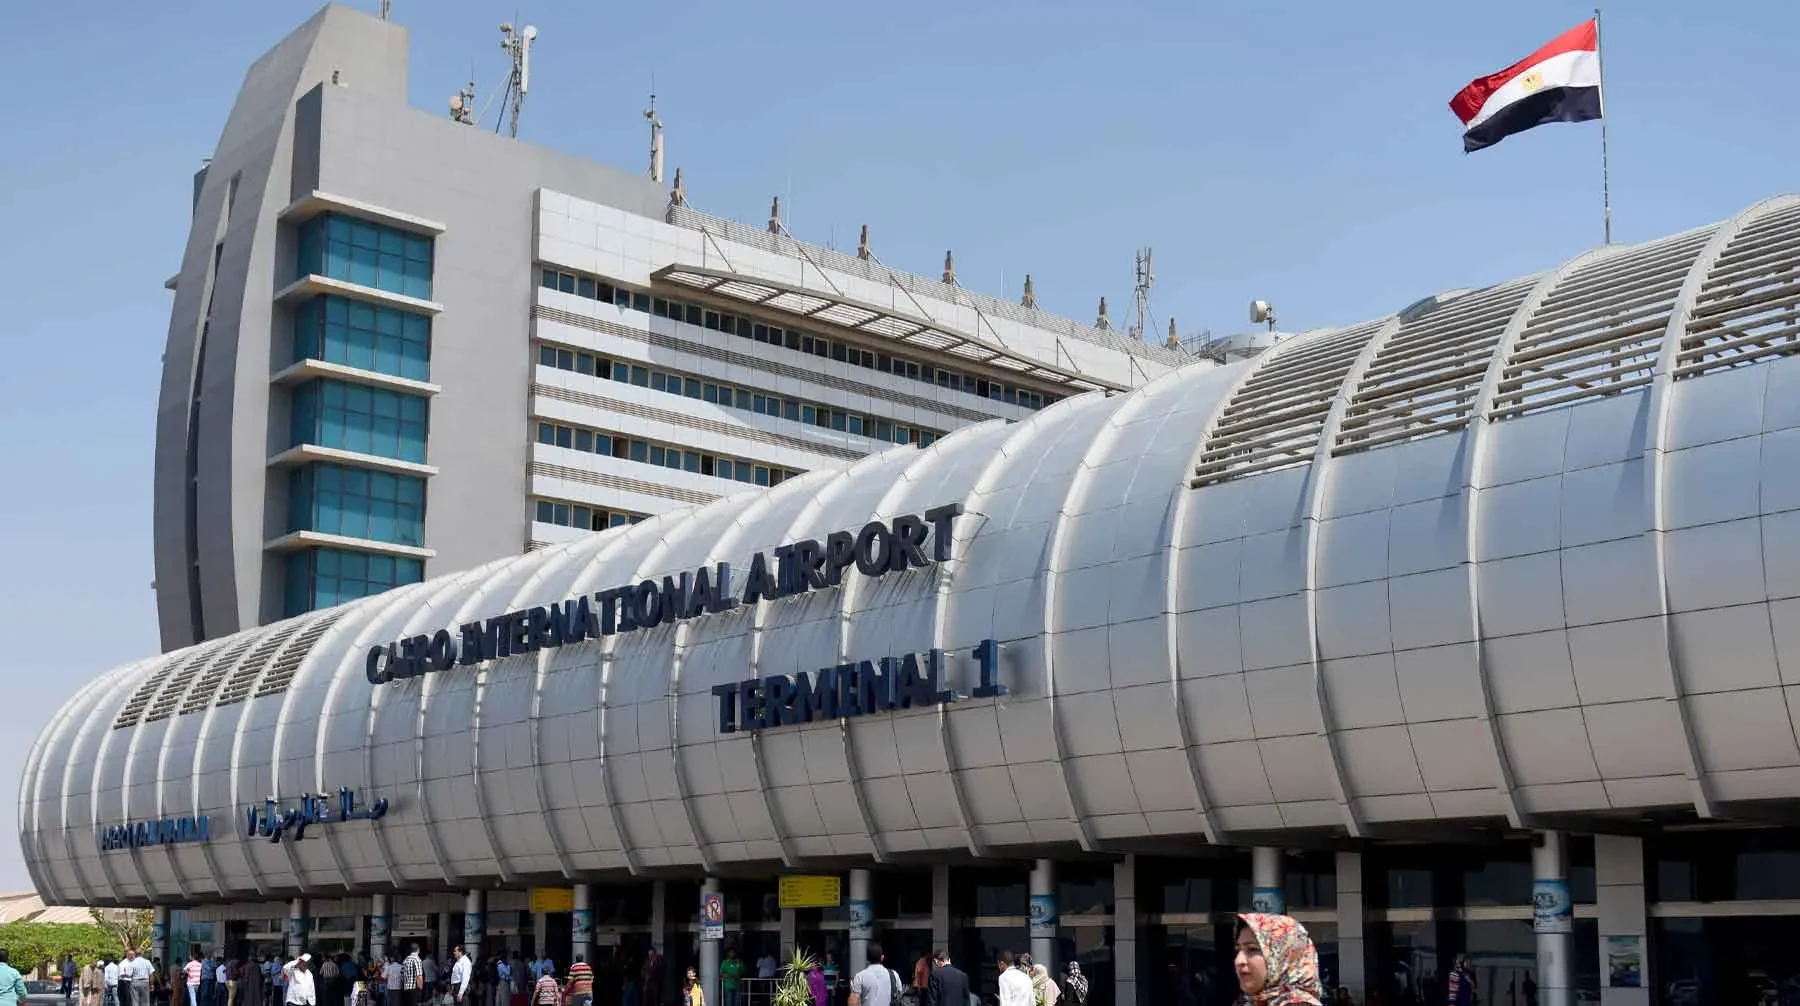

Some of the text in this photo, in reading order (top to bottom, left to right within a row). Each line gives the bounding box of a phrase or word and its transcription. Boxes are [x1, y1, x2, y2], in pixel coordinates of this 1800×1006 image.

[366, 503, 964, 684] CAIRO INTERNATIONAL AIRPORT
[712, 639, 1007, 733] TERMINAL 1
